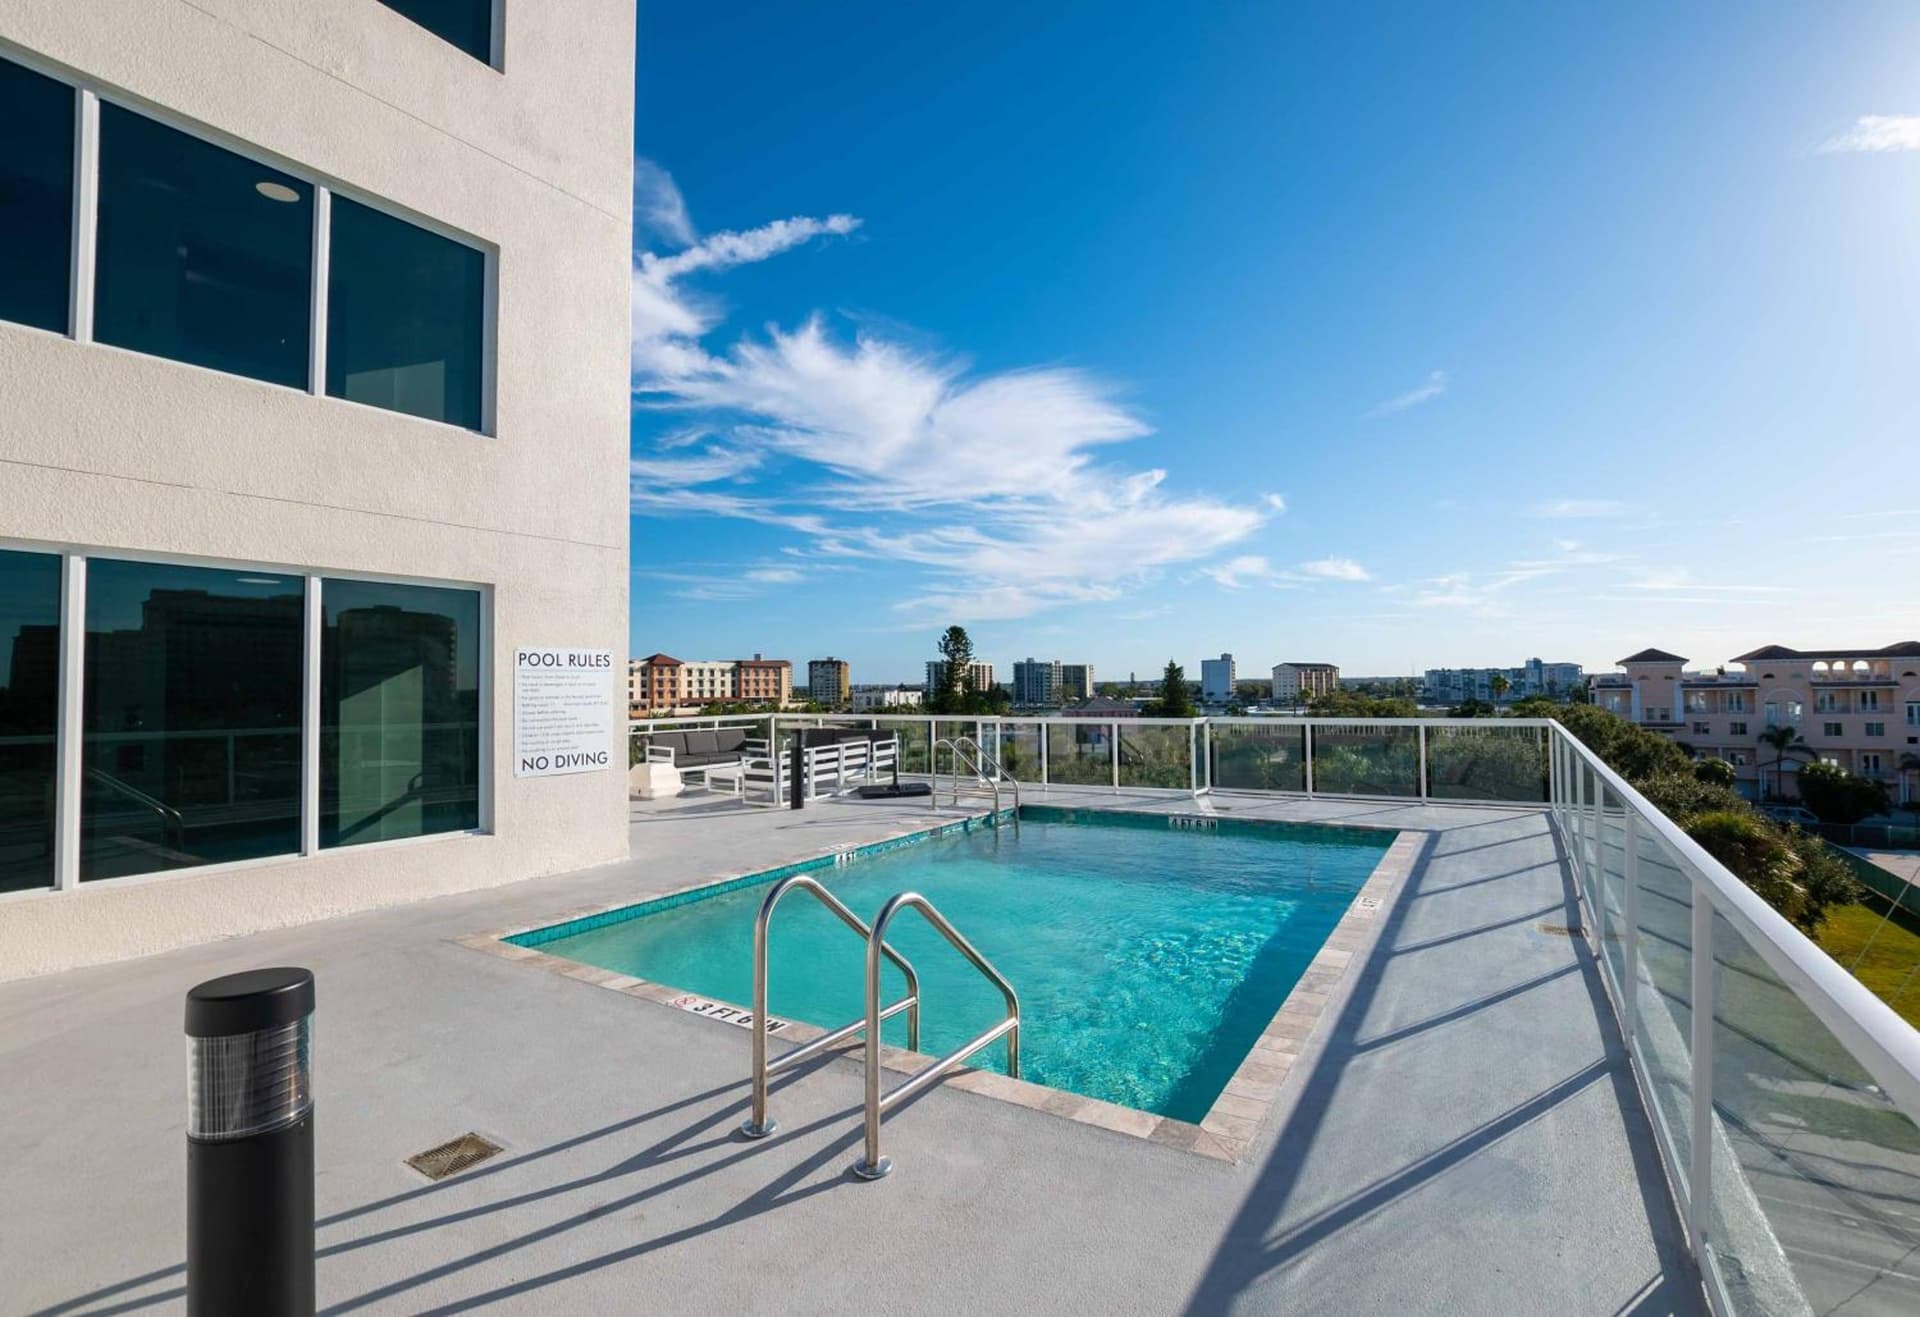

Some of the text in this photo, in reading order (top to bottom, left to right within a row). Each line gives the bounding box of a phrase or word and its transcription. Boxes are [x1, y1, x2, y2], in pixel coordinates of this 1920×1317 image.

[519, 652, 611, 668] POOL RULES
[522, 751, 608, 772] NO DIVING
[694, 1003, 713, 1011] 3
[708, 1007, 742, 1019] FT
